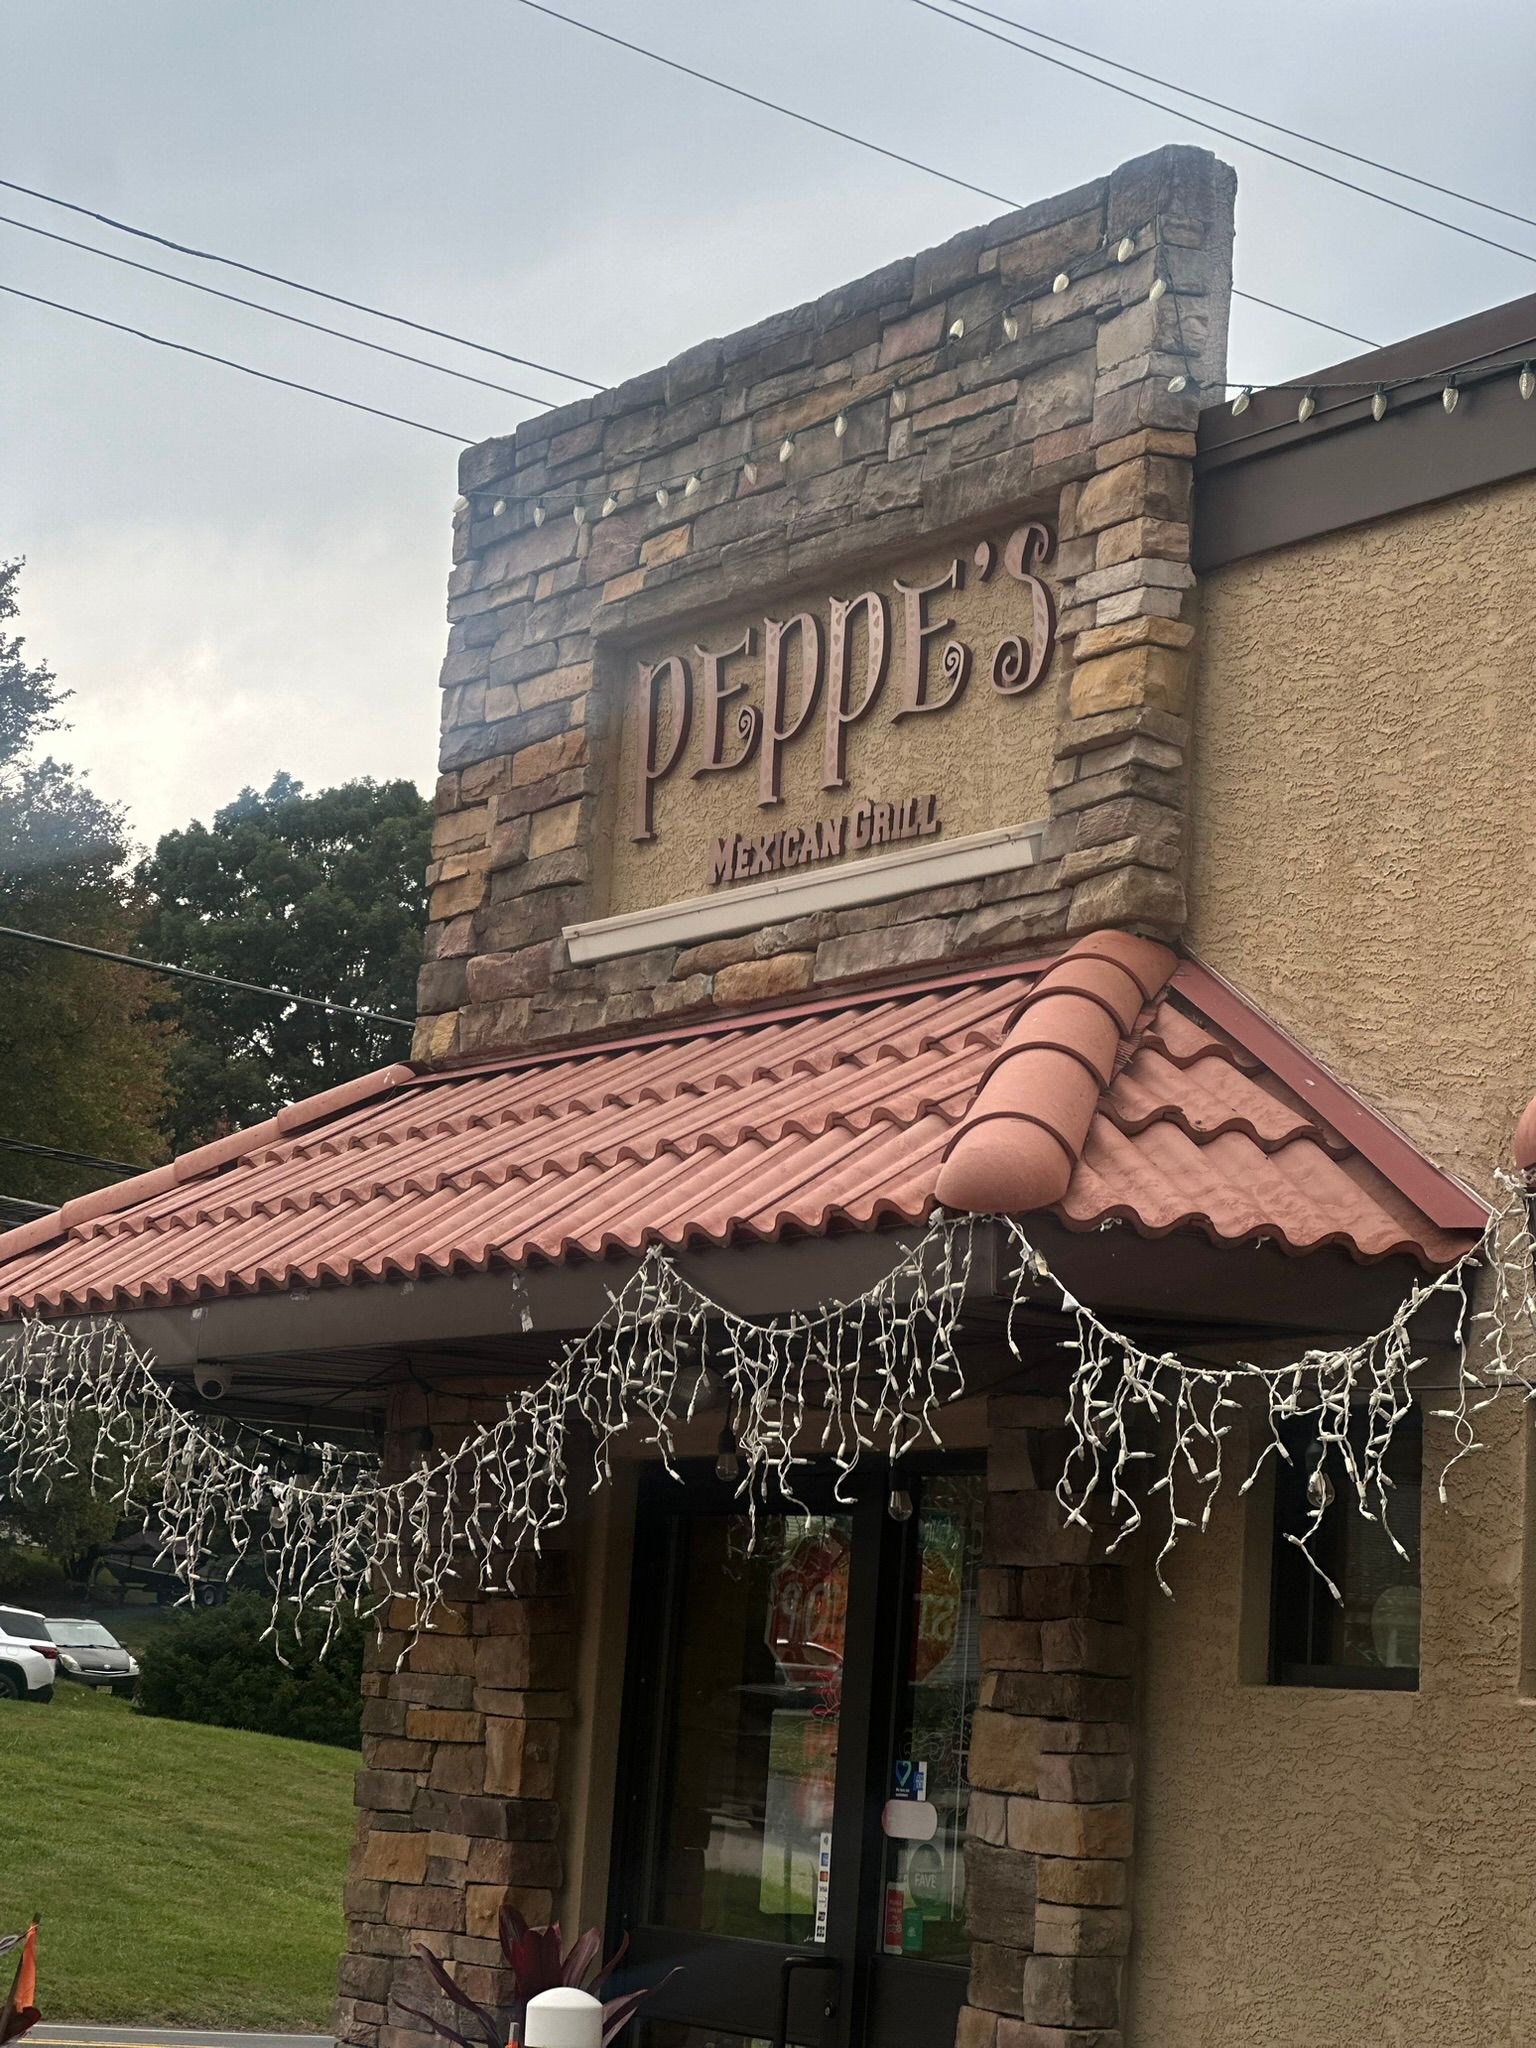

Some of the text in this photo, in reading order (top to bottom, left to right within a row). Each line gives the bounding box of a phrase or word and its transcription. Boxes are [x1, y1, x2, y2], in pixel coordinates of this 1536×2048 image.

[629, 520, 1057, 844] PEPPE'S
[707, 794, 943, 886] MEXICAN GRILL
